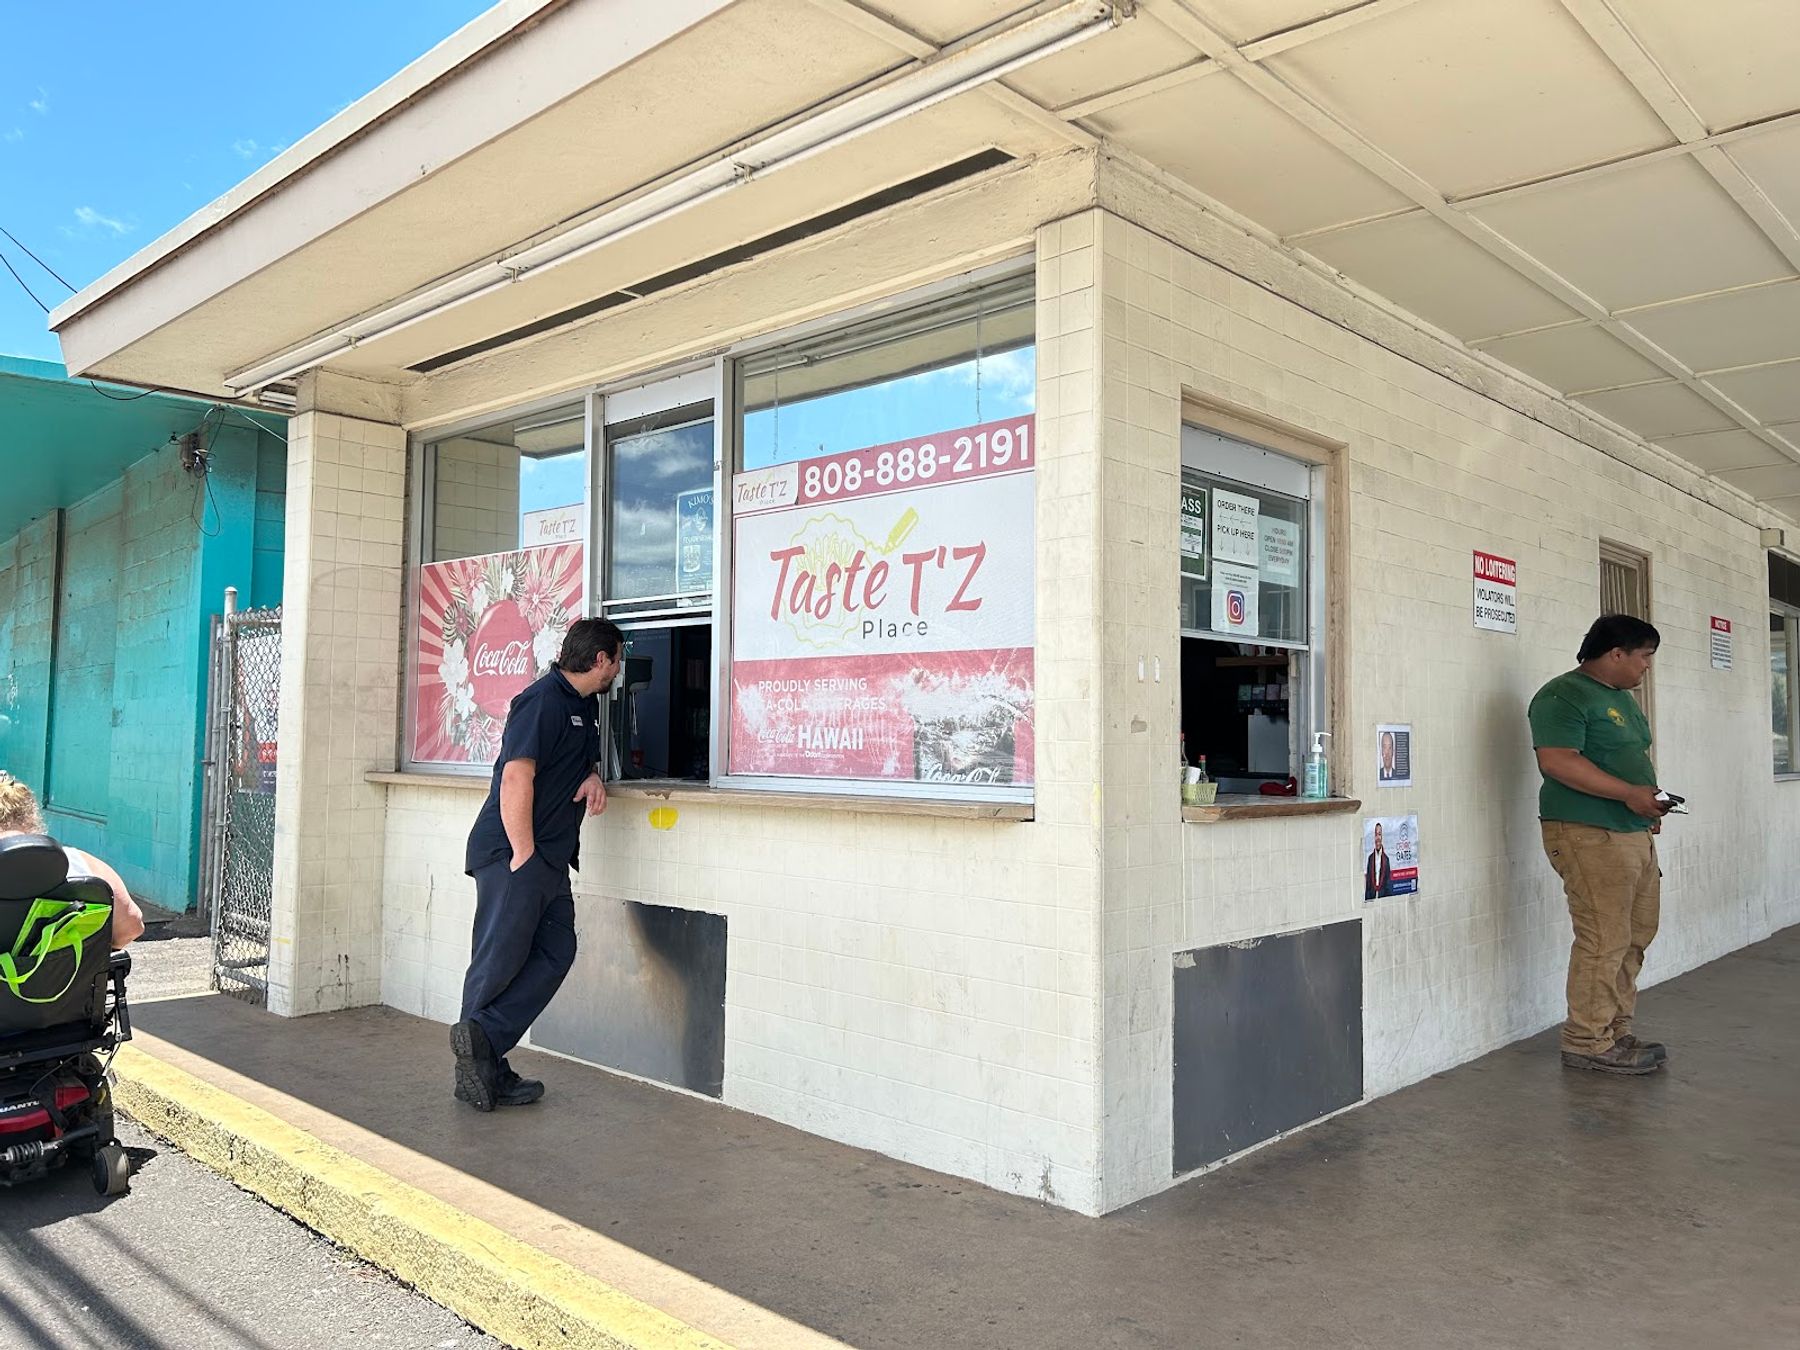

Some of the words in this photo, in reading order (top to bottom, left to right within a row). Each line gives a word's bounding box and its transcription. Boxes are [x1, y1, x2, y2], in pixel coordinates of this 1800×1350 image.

[804, 424, 1029, 499] 808-888-2191
[738, 482, 767, 503] Taste
[1217, 499, 1236, 511] ORDER
[1237, 504, 1255, 517] THERE
[540, 519, 561, 536] Taste
[1217, 524, 1231, 535] PICK
[1240, 530, 1255, 540] HERE
[1475, 554, 1484, 575] NO
[1485, 557, 1516, 583] LOITERING
[770, 546, 889, 621] Taste
[902, 540, 986, 616] T'Z
[1476, 587, 1503, 605] VIOLATORS
[1504, 593, 1515, 607] WILL
[1476, 606, 1483, 618] BE
[1484, 607, 1516, 624] PROSECUTED
[863, 619, 928, 639] Place
[758, 679, 811, 693] PROUDLY
[814, 677, 868, 692] SERVING
[797, 724, 864, 750] HAWAII
